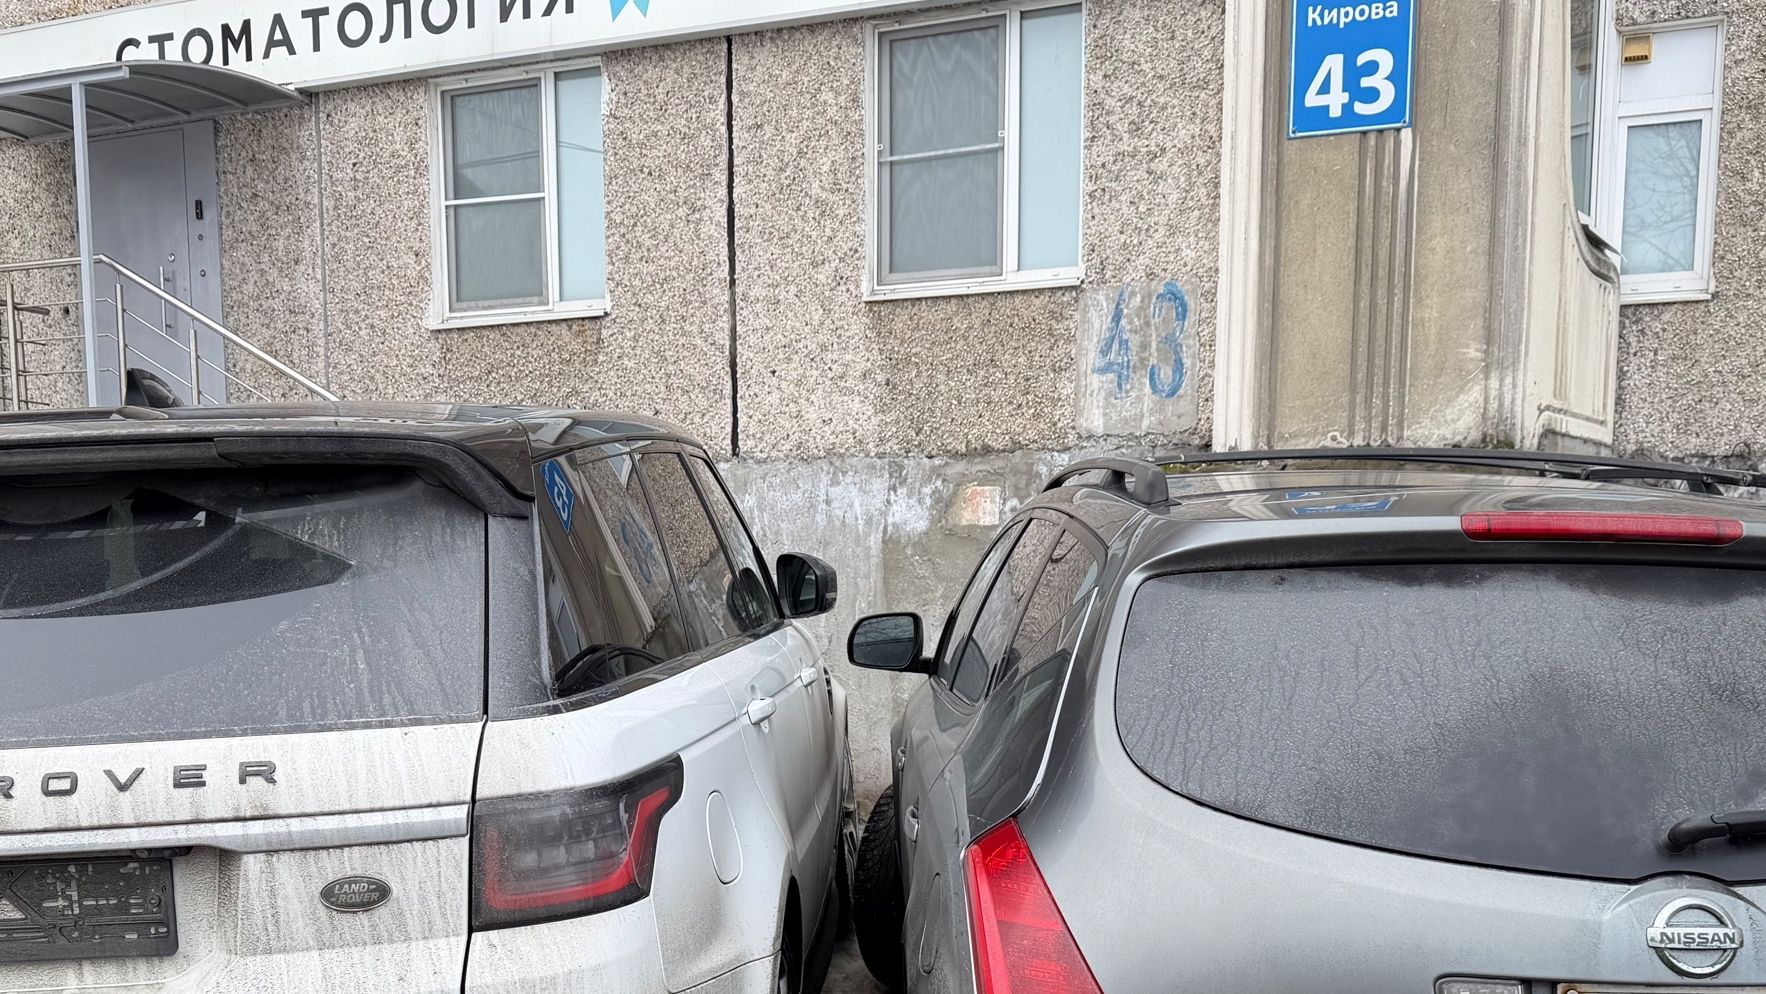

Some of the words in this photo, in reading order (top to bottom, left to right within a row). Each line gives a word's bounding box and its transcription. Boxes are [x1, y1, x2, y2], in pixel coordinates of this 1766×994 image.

[1307, 0, 1399, 28] Кирова
[1304, 48, 1396, 118] 43
[1092, 280, 1189, 400] 43
[1659, 931, 1736, 947] NISSAN
